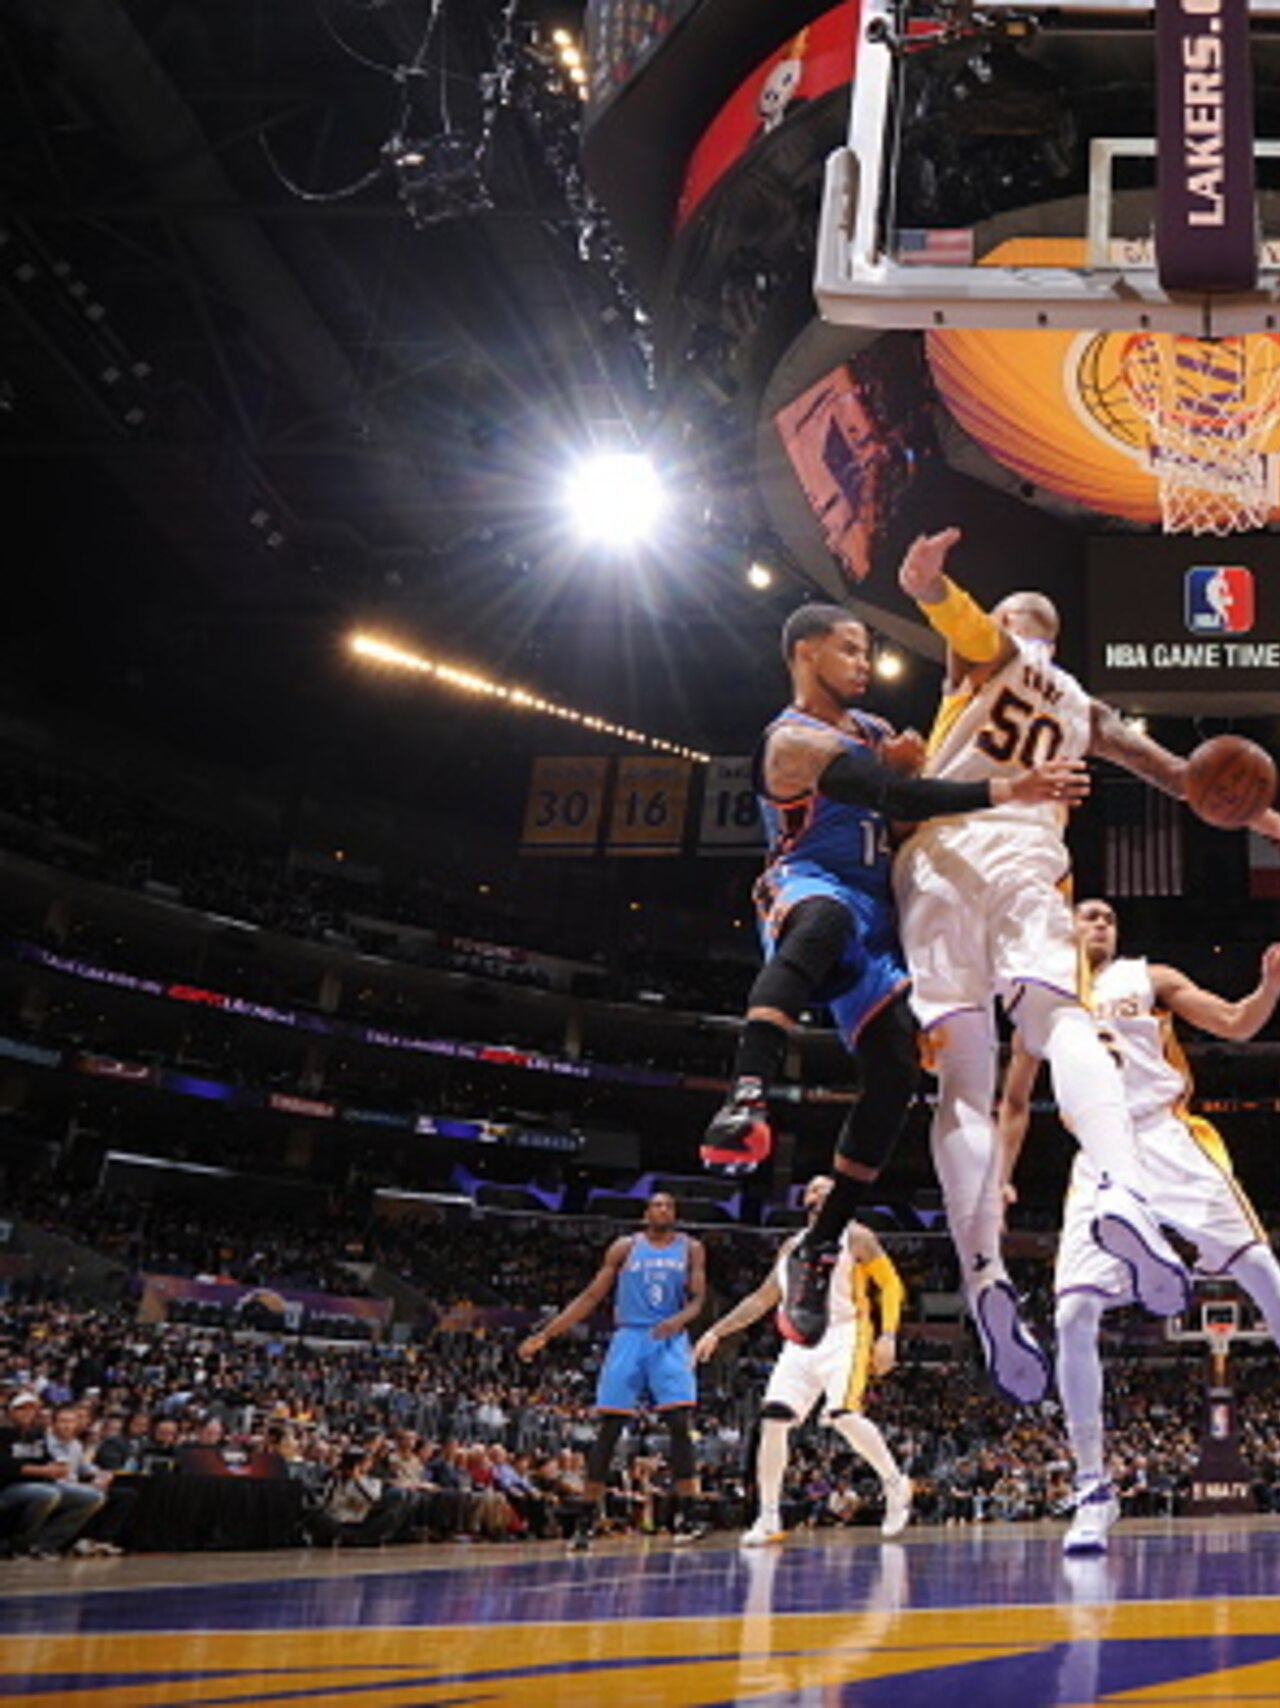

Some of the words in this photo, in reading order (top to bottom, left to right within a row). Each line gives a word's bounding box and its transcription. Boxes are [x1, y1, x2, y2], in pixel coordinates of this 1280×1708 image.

[1105, 643, 1148, 668] NBA
[1151, 643, 1221, 668] GAME
[975, 684, 1064, 770] 50
[535, 789, 590, 827] 30
[626, 789, 668, 827] 16
[717, 789, 759, 827] 18
